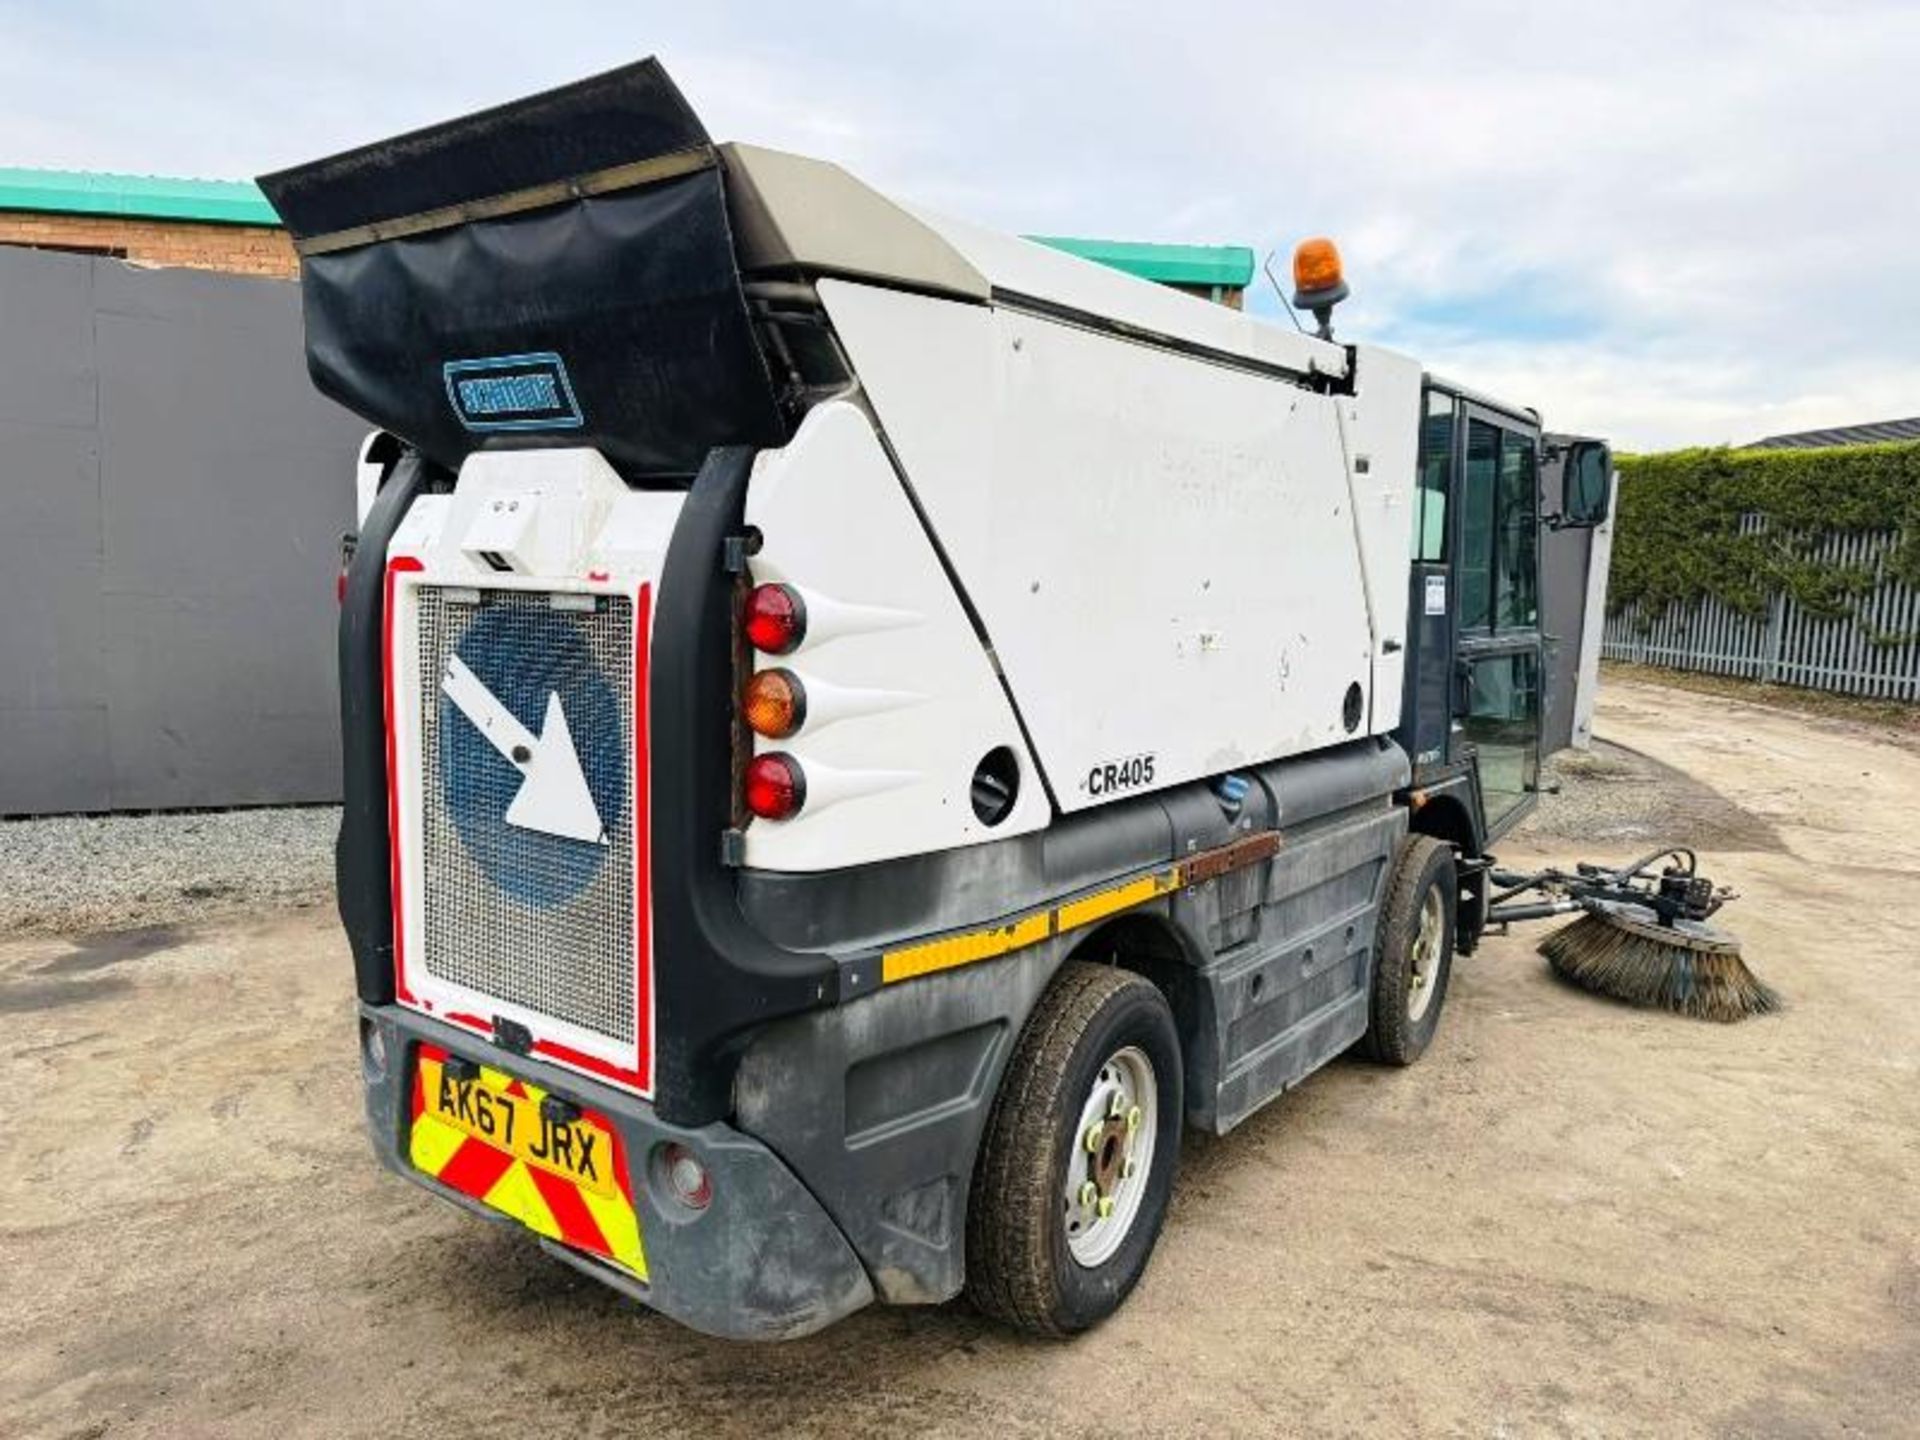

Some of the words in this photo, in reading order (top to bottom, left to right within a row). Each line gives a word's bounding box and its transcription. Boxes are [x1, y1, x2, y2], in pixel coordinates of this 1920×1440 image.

[1088, 755, 1155, 795] CR405
[438, 1075, 515, 1146] AK67
[529, 1098, 598, 1183] JRX
